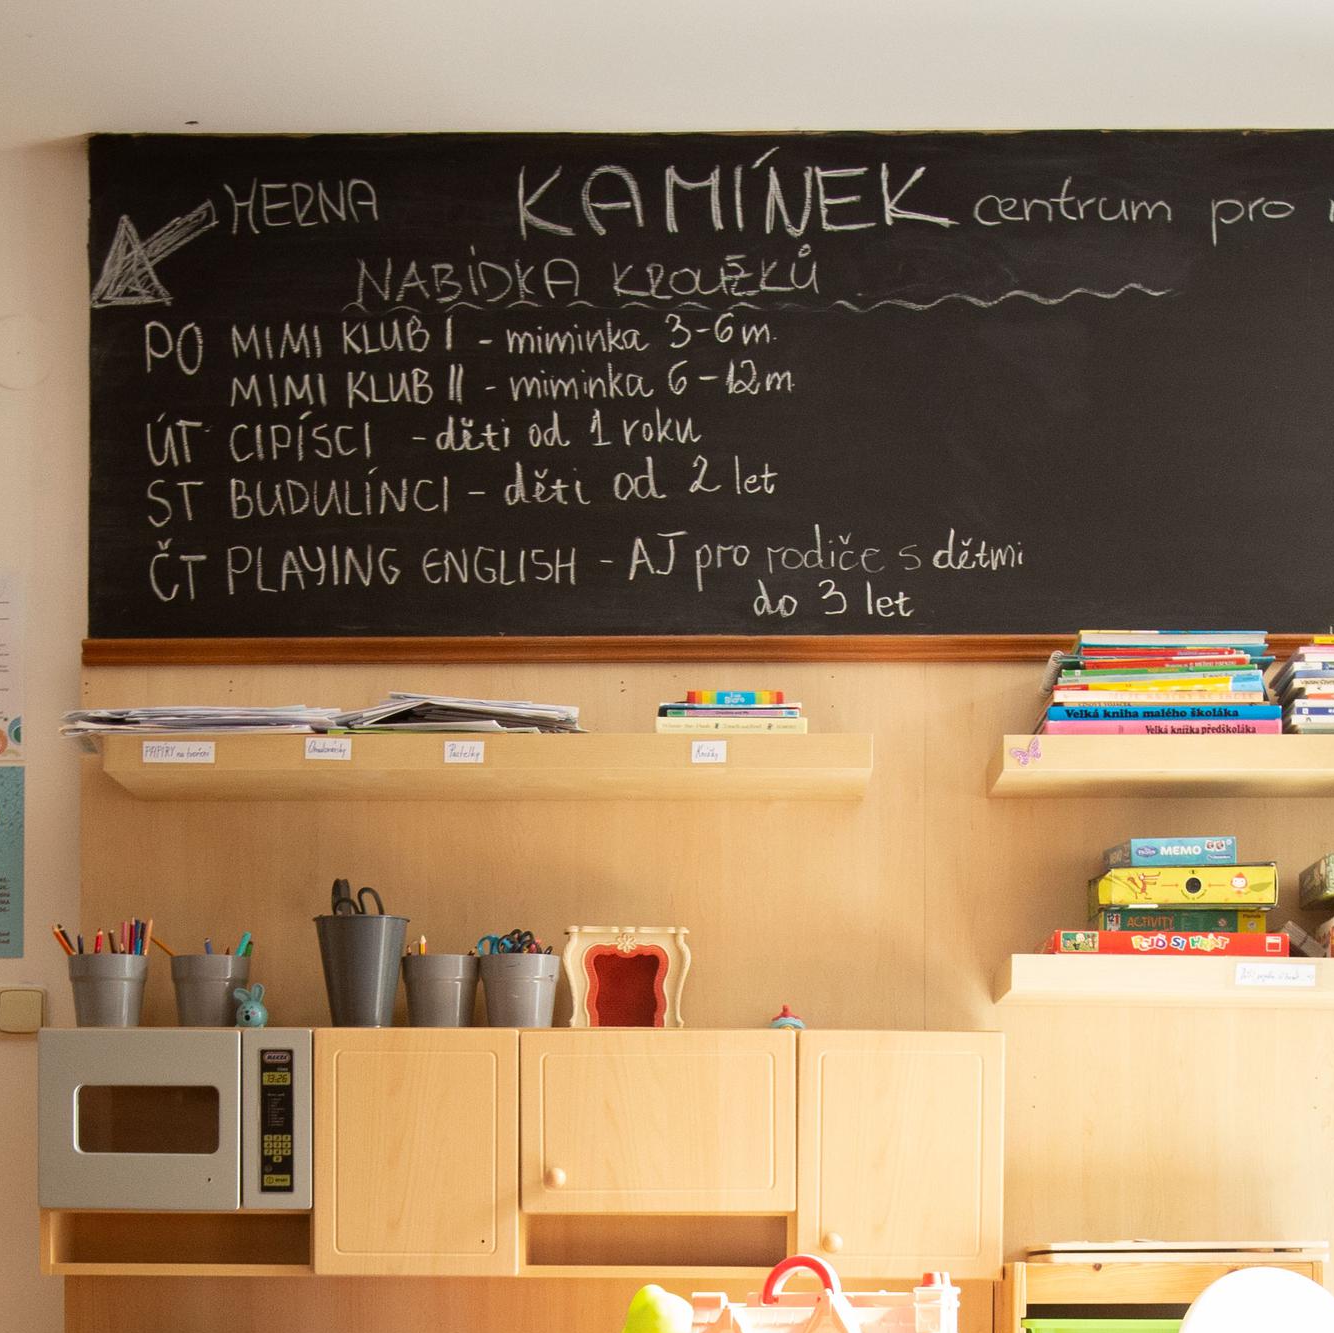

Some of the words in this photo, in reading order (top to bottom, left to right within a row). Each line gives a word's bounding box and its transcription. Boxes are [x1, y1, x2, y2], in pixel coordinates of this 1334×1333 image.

[223, 178, 379, 234] HERNA
[517, 146, 960, 240] KAMÍNEK
[973, 176, 1172, 226] centrum
[1211, 197, 1295, 246] pro
[357, 245, 580, 300] NABÍDKA
[144, 320, 204, 376] PO
[231, 321, 322, 359] MIMI
[342, 315, 430, 355] KLUB
[506, 318, 650, 354] miminka
[230, 373, 327, 408] MIMI
[347, 367, 434, 407] KLUB
[509, 362, 655, 401] miminka
[229, 410, 372, 463] CIPÍSCI
[435, 414, 510, 452] děti
[528, 410, 571, 448] od
[589, 408, 612, 446] 1
[622, 407, 702, 446] roku
[147, 479, 204, 528] ST
[230, 467, 449, 520] BUDULÍNCI
[504, 461, 591, 506] děti
[613, 456, 667, 501] od
[688, 454, 722, 493] 2
[734, 455, 778, 495] let
[149, 538, 207, 602] ČT
[227, 544, 401, 595] PLAYING
[422, 546, 576, 586] ENGLISH
[628, 530, 688, 580] AJ
[695, 543, 750, 592] pro
[767, 523, 884, 571] rodiče
[898, 544, 922, 571] s
[932, 528, 1023, 571] dětmi
[753, 579, 798, 617] do
[818, 579, 848, 615] 3
[866, 581, 914, 617] let
[1065, 709, 1099, 718] Velká
[1103, 709, 1139, 718] kniha
[1143, 708, 1187, 718] malého
[1190, 707, 1239, 718] školáka
[1145, 724, 1168, 734] Velká
[1170, 724, 1199, 734] knížka
[1201, 721, 1256, 735] předškoláka
[1160, 845, 1202, 856] MEMO
[1127, 915, 1174, 927] ACTIVITY
[1170, 937, 1187, 951] SI
